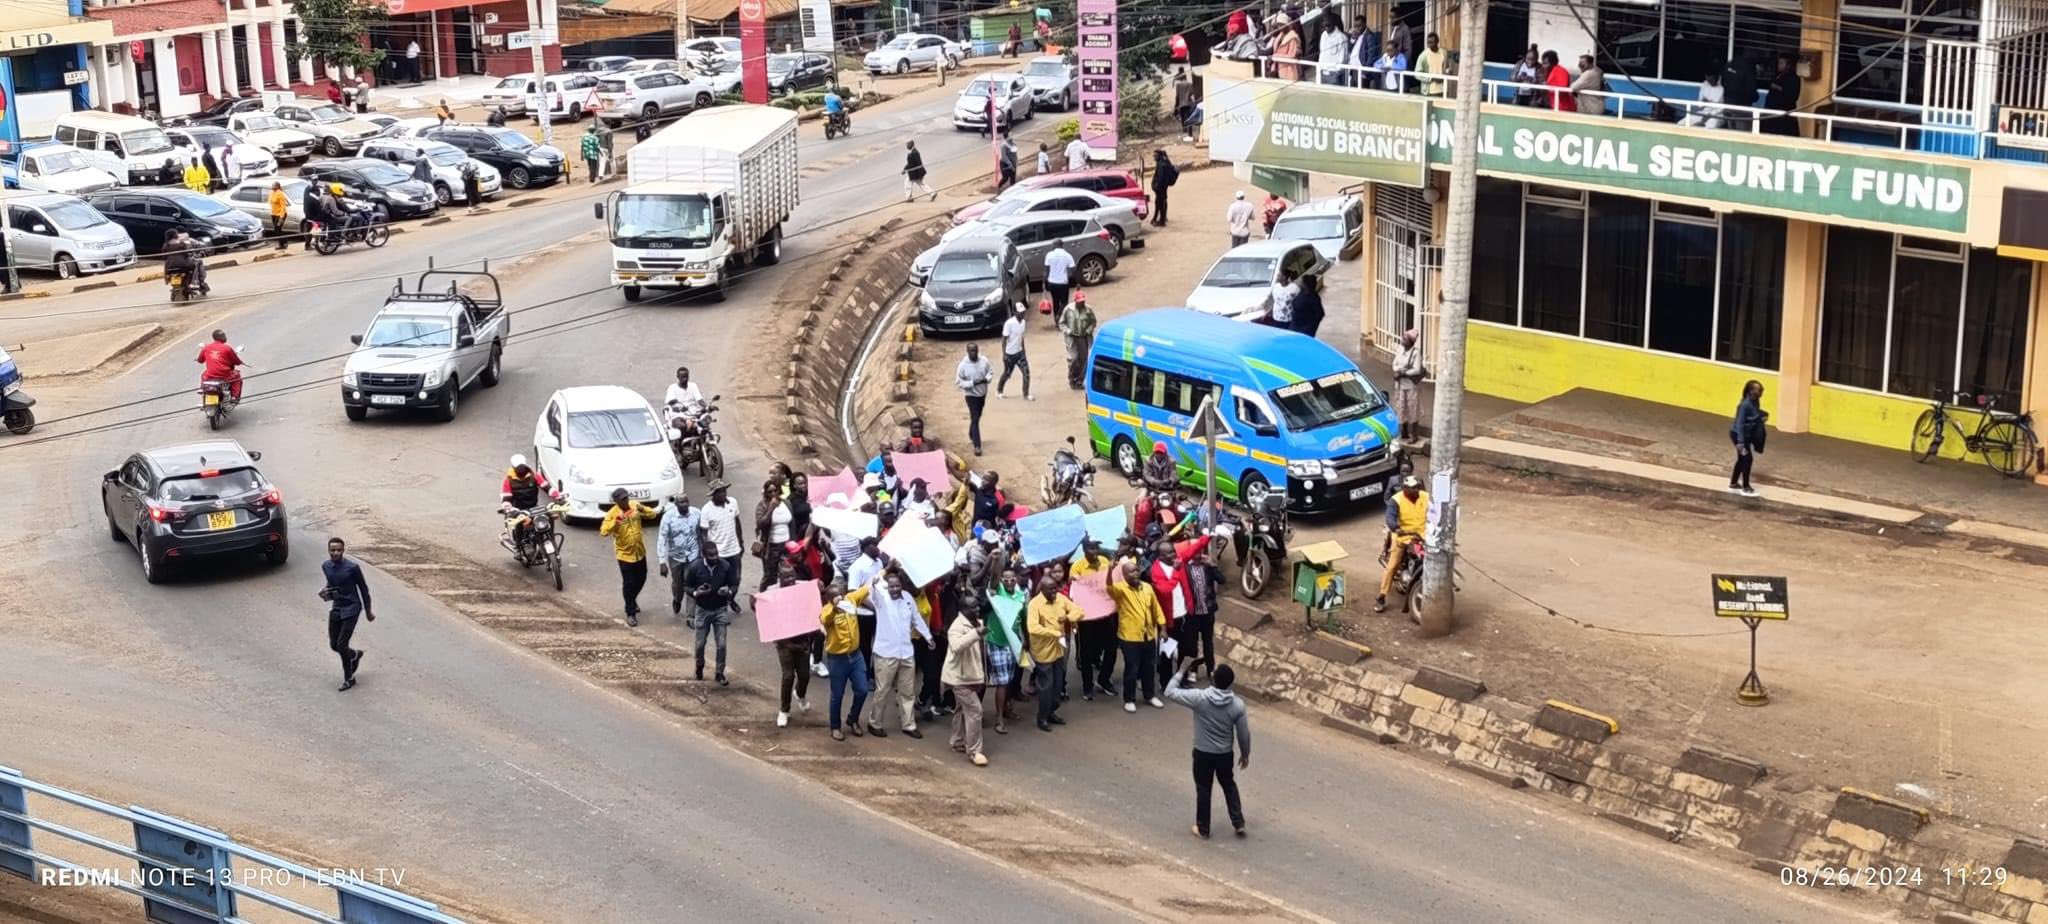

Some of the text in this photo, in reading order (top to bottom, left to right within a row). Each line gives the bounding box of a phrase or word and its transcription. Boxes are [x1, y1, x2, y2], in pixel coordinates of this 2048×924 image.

[1271, 112, 1421, 140] NATIONAL SOCIAL SECURITY FUND
[1271, 124, 1421, 163] EMBU BRANCH
[1513, 128, 1639, 174] SOCIAL
[1648, 145, 1842, 197] SECURITY
[1851, 167, 1964, 213] FUND
